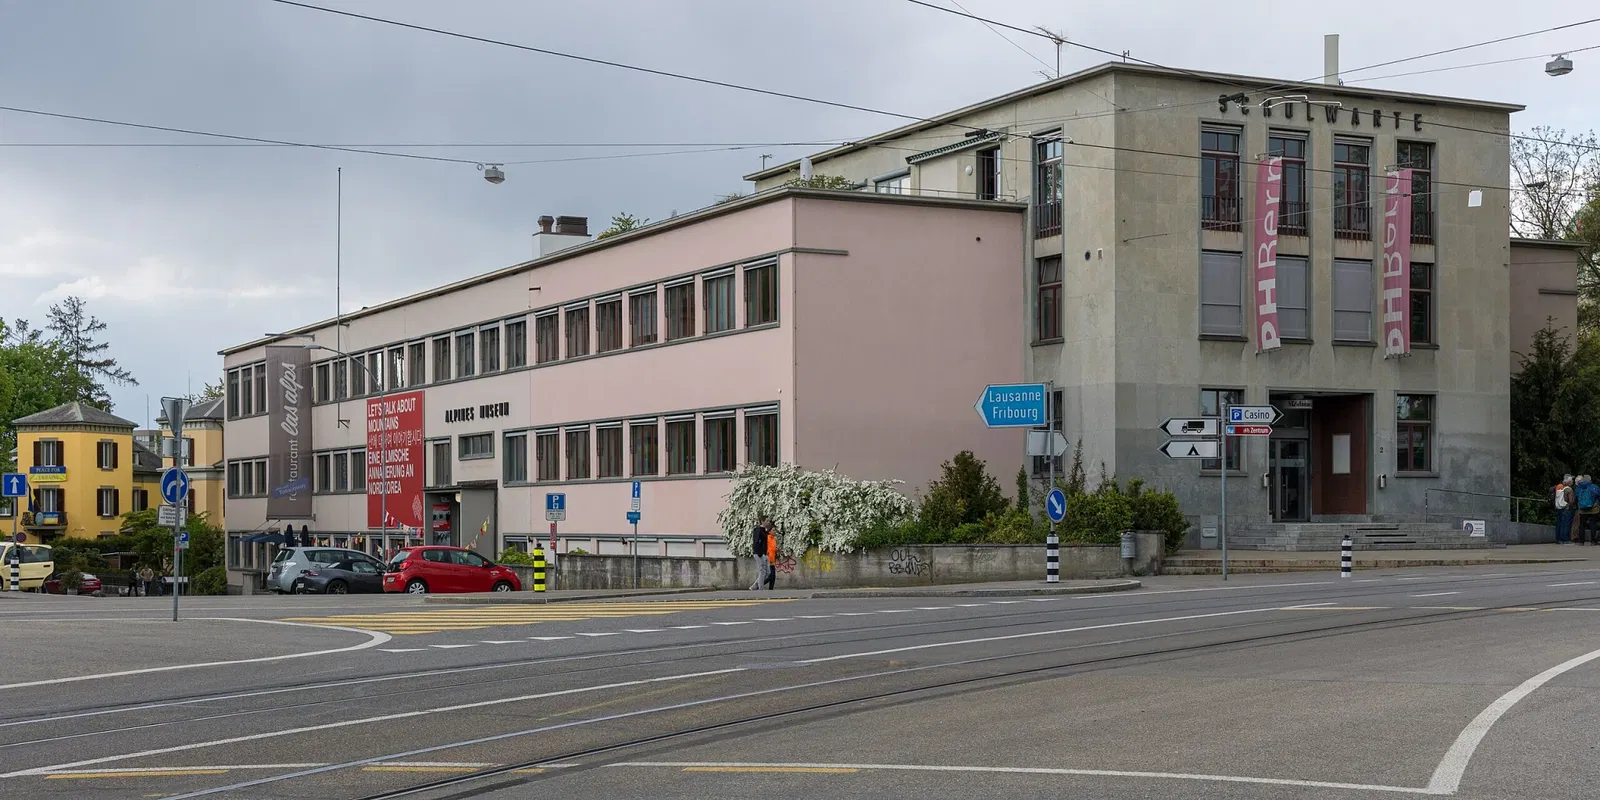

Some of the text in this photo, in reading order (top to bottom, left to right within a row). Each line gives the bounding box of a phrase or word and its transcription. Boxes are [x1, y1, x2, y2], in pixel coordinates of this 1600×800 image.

[1218, 94, 1423, 132] SCHULWARTE
[1258, 156, 1282, 350] PHBern
[989, 390, 1041, 403] Lausanne
[368, 402, 382, 417] LET'S
[397, 397, 416, 413] ABOUT
[445, 402, 509, 423] ALPINES MUSEUM
[993, 406, 1038, 421] Fribourg
[1244, 409, 1270, 419] Casino
[279, 362, 303, 501] retaurant las alps
[368, 416, 399, 432] MOUNTAINS
[368, 448, 410, 464] EINE FLMISCHE
[368, 463, 414, 480] ANNÄERUNG AN
